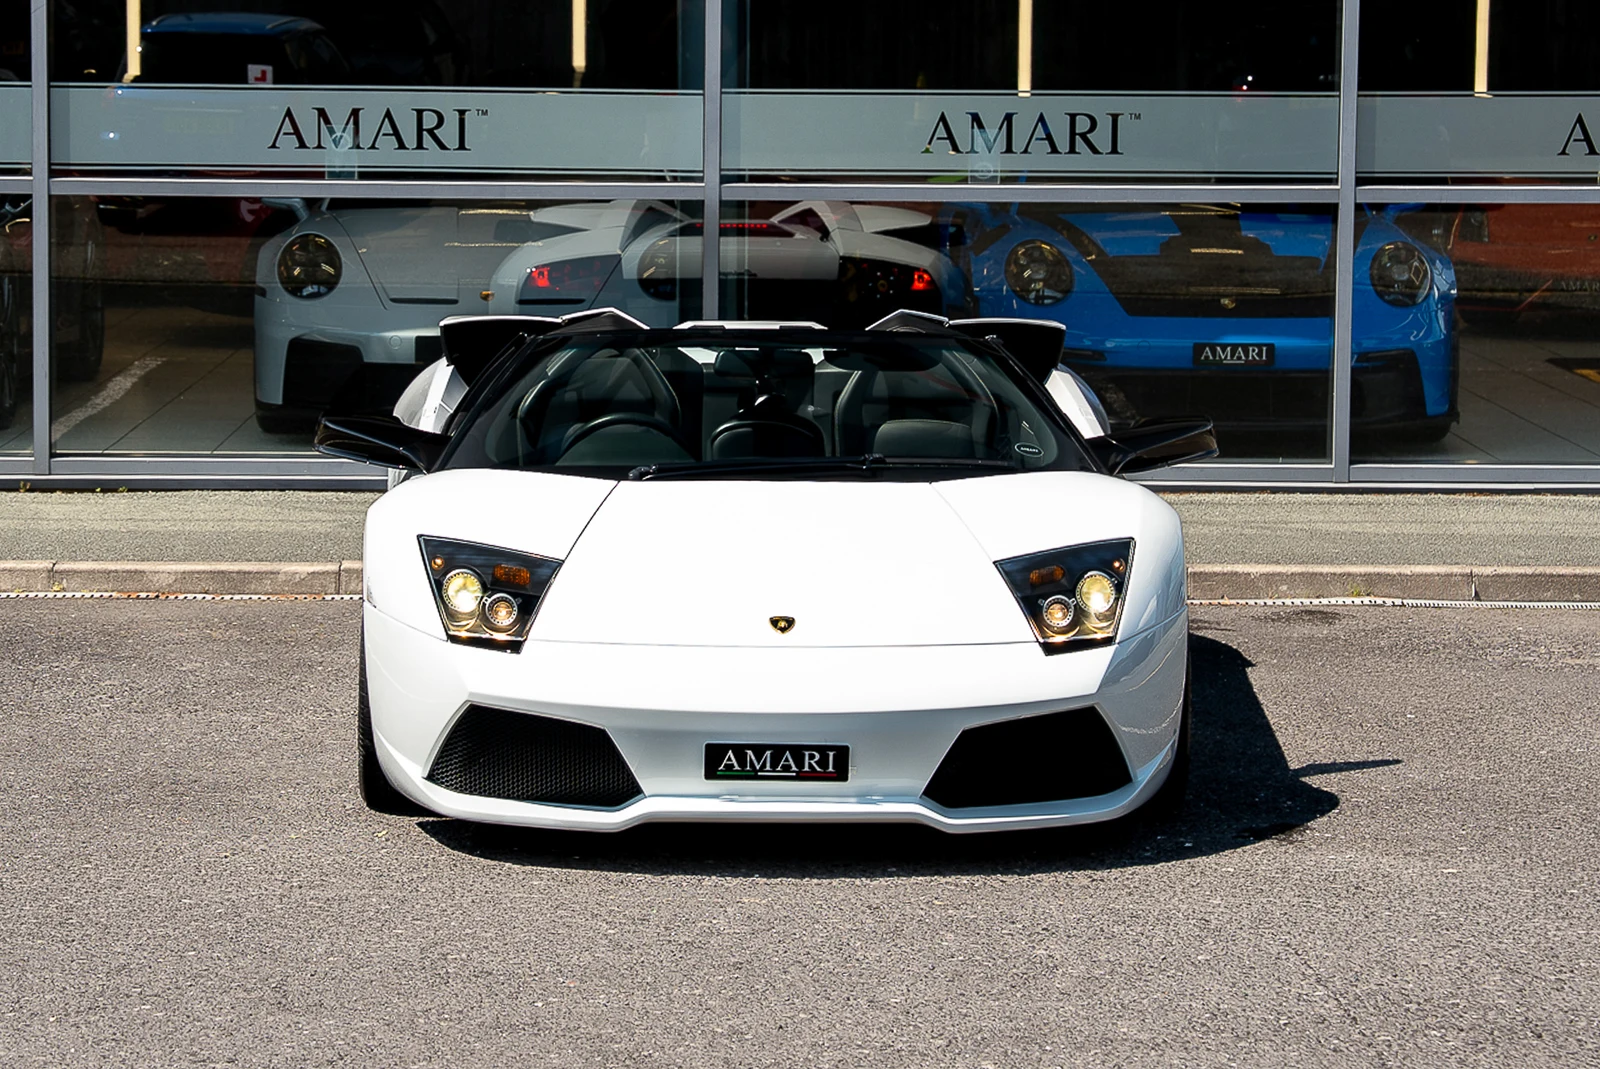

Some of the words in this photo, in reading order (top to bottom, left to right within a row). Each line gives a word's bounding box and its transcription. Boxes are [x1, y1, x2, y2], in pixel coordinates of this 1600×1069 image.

[267, 106, 472, 151] AMARI
[921, 111, 1125, 155] AMARI
[1200, 346, 1268, 361] AMARI
[717, 749, 837, 772] AMARI
